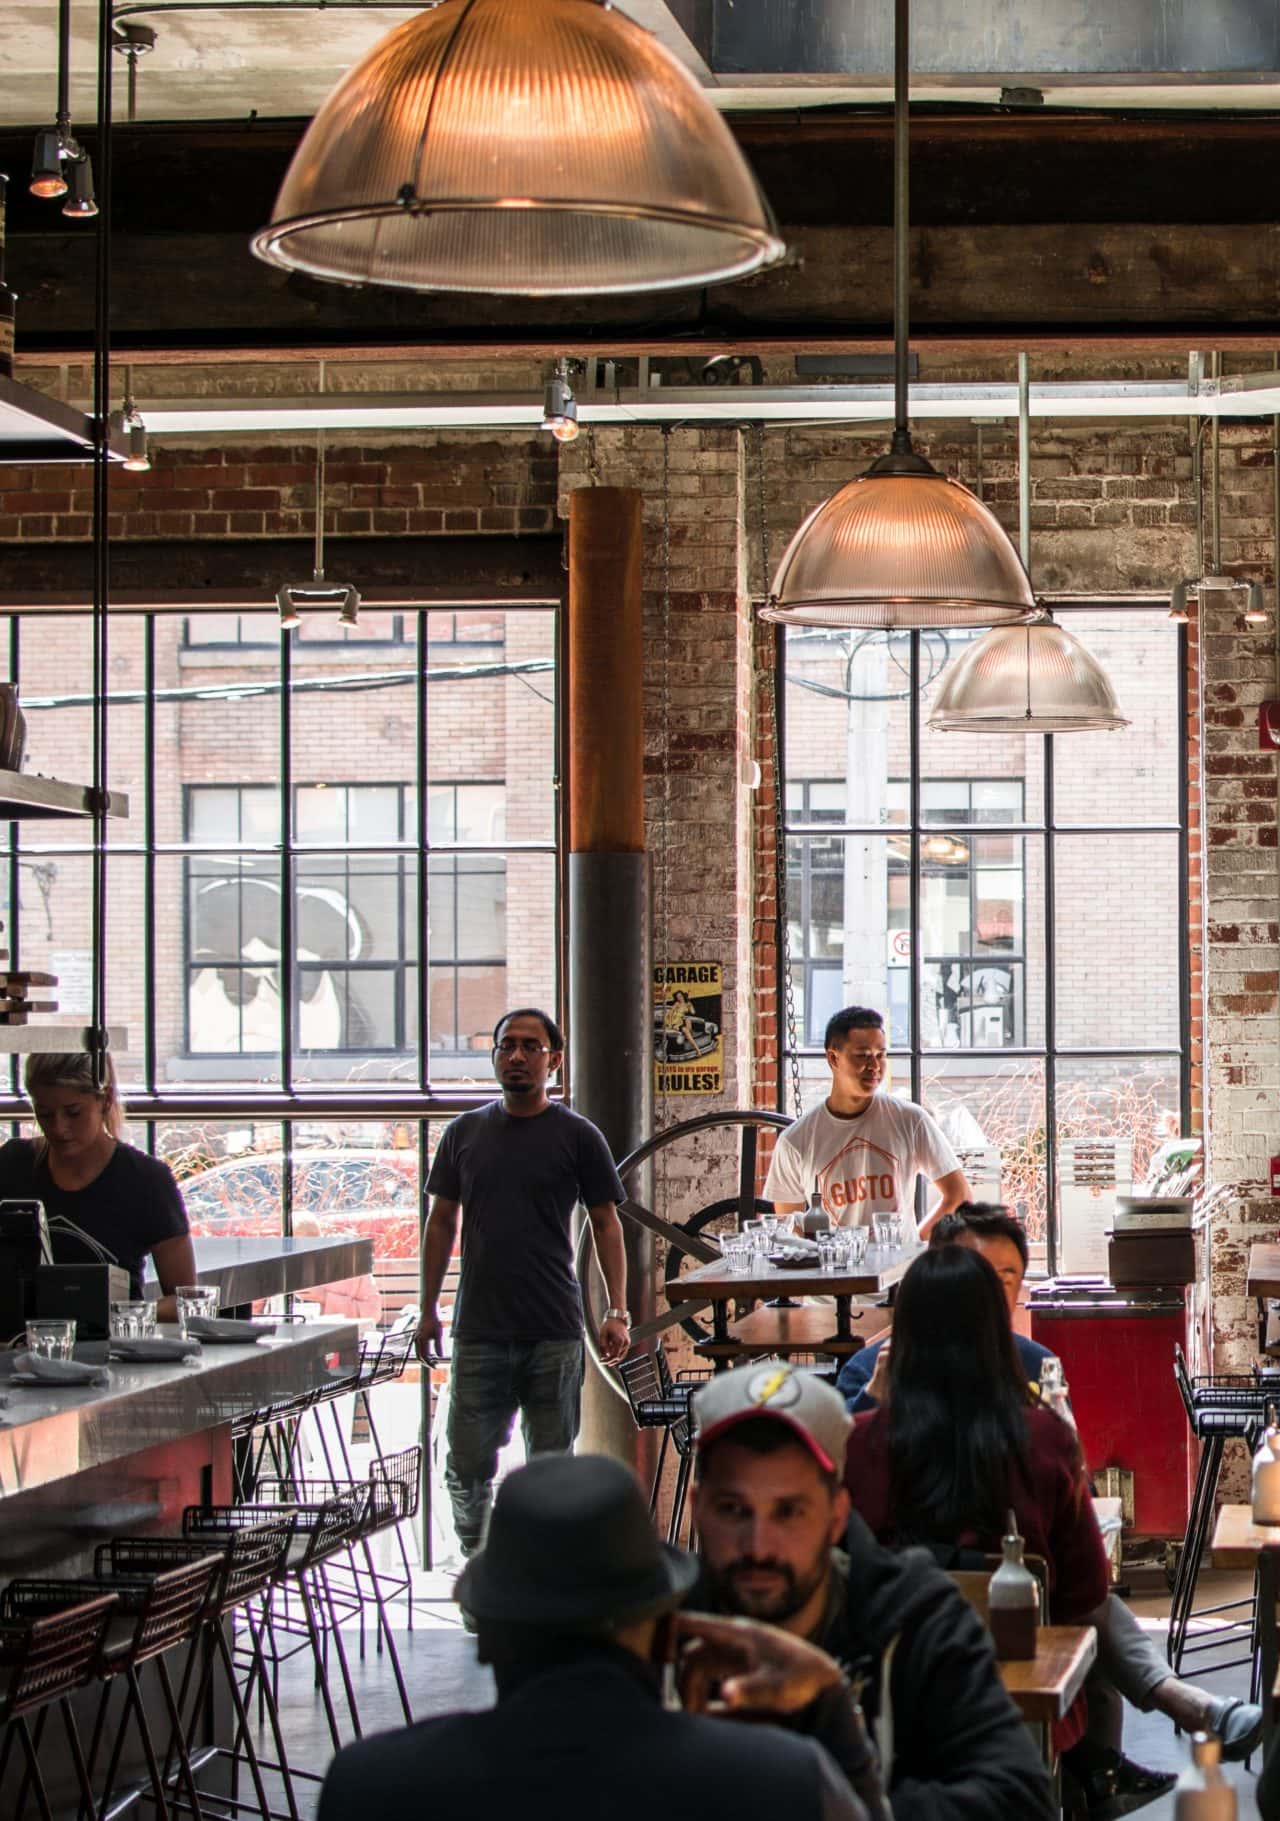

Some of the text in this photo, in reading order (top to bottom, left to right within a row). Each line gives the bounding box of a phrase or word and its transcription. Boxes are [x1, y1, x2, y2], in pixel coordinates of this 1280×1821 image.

[655, 966, 718, 983] GARAGE
[658, 1073, 720, 1091] RULES!
[831, 1174, 893, 1206] GUSTO
